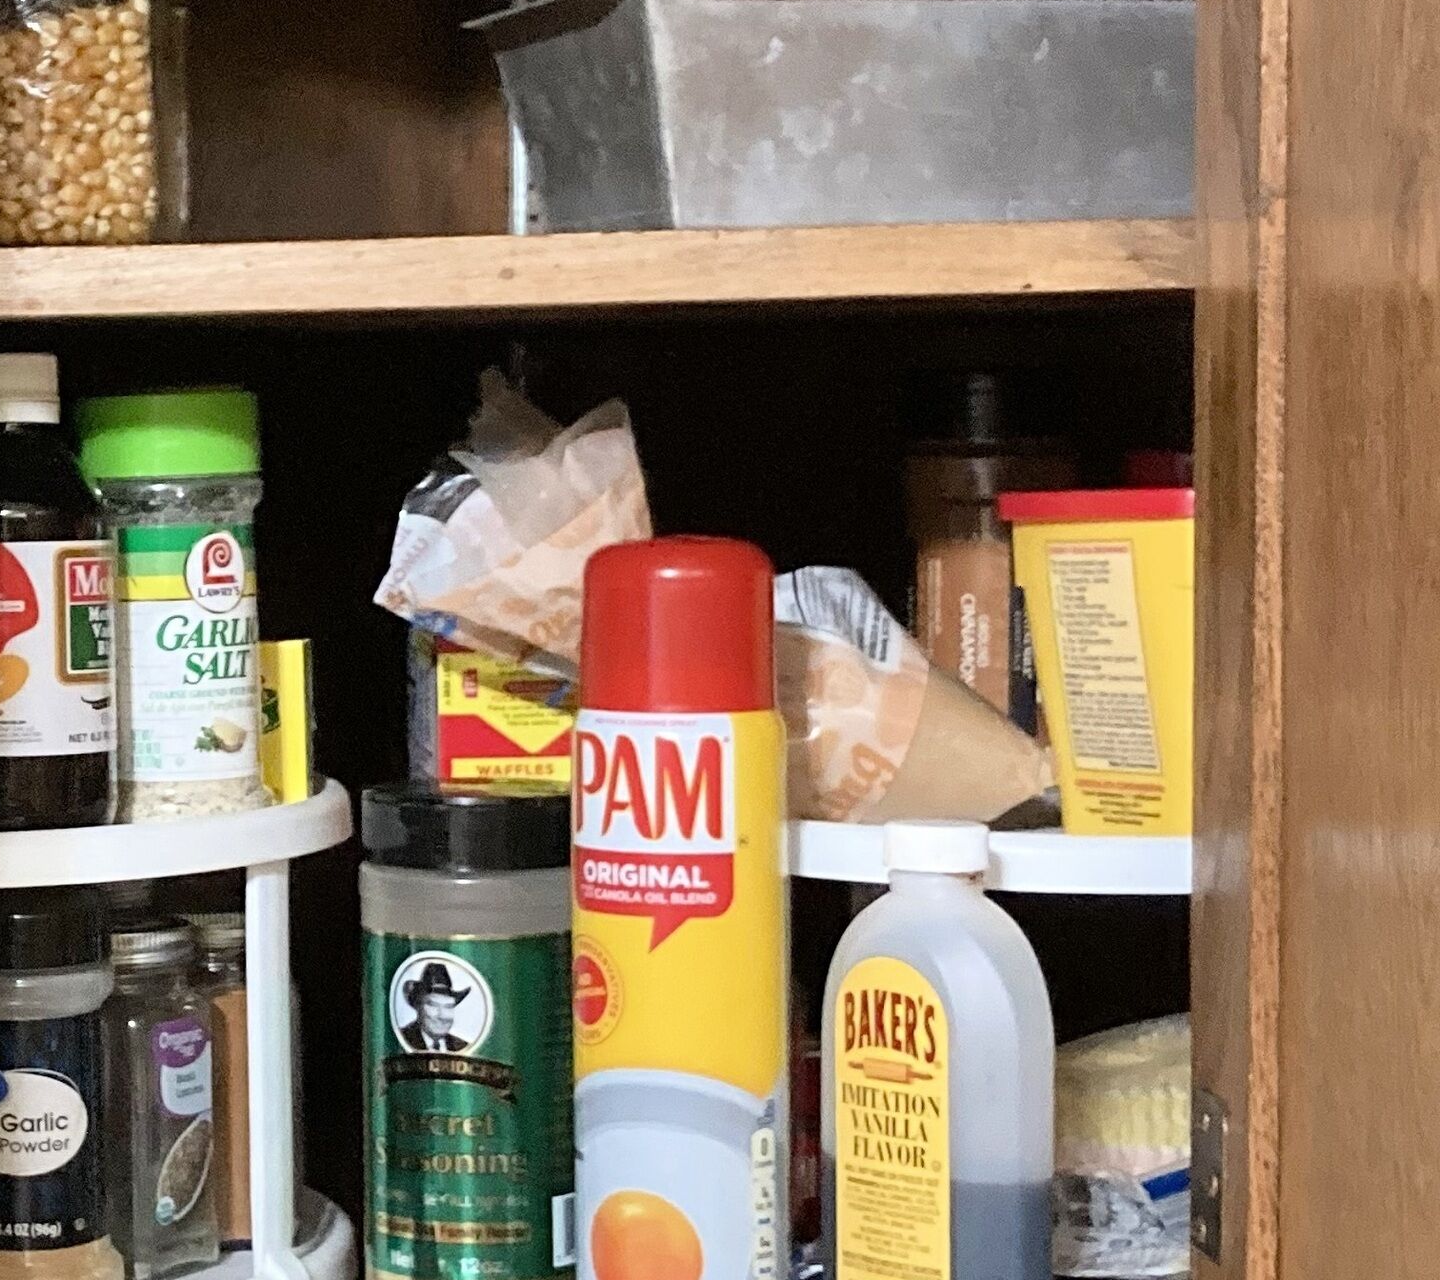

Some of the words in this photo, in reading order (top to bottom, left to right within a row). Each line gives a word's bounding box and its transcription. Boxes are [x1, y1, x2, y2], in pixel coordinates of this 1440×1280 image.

[183, 649, 251, 685] SALT
[476, 763, 554, 776] WAFFLES
[577, 730, 722, 841] PAM
[583, 859, 710, 889] ORIGINAL
[594, 888, 642, 903] CANOLA
[644, 891, 668, 904] OIL
[670, 892, 717, 905] BLEND
[844, 989, 937, 1063] BAKER'S
[841, 1082, 941, 1118] IMITATION
[0, 1111, 69, 1133] Garlic
[851, 1108, 929, 1143] VANILLA
[0, 1137, 70, 1154] Powder
[853, 1135, 926, 1169] FLAVOR
